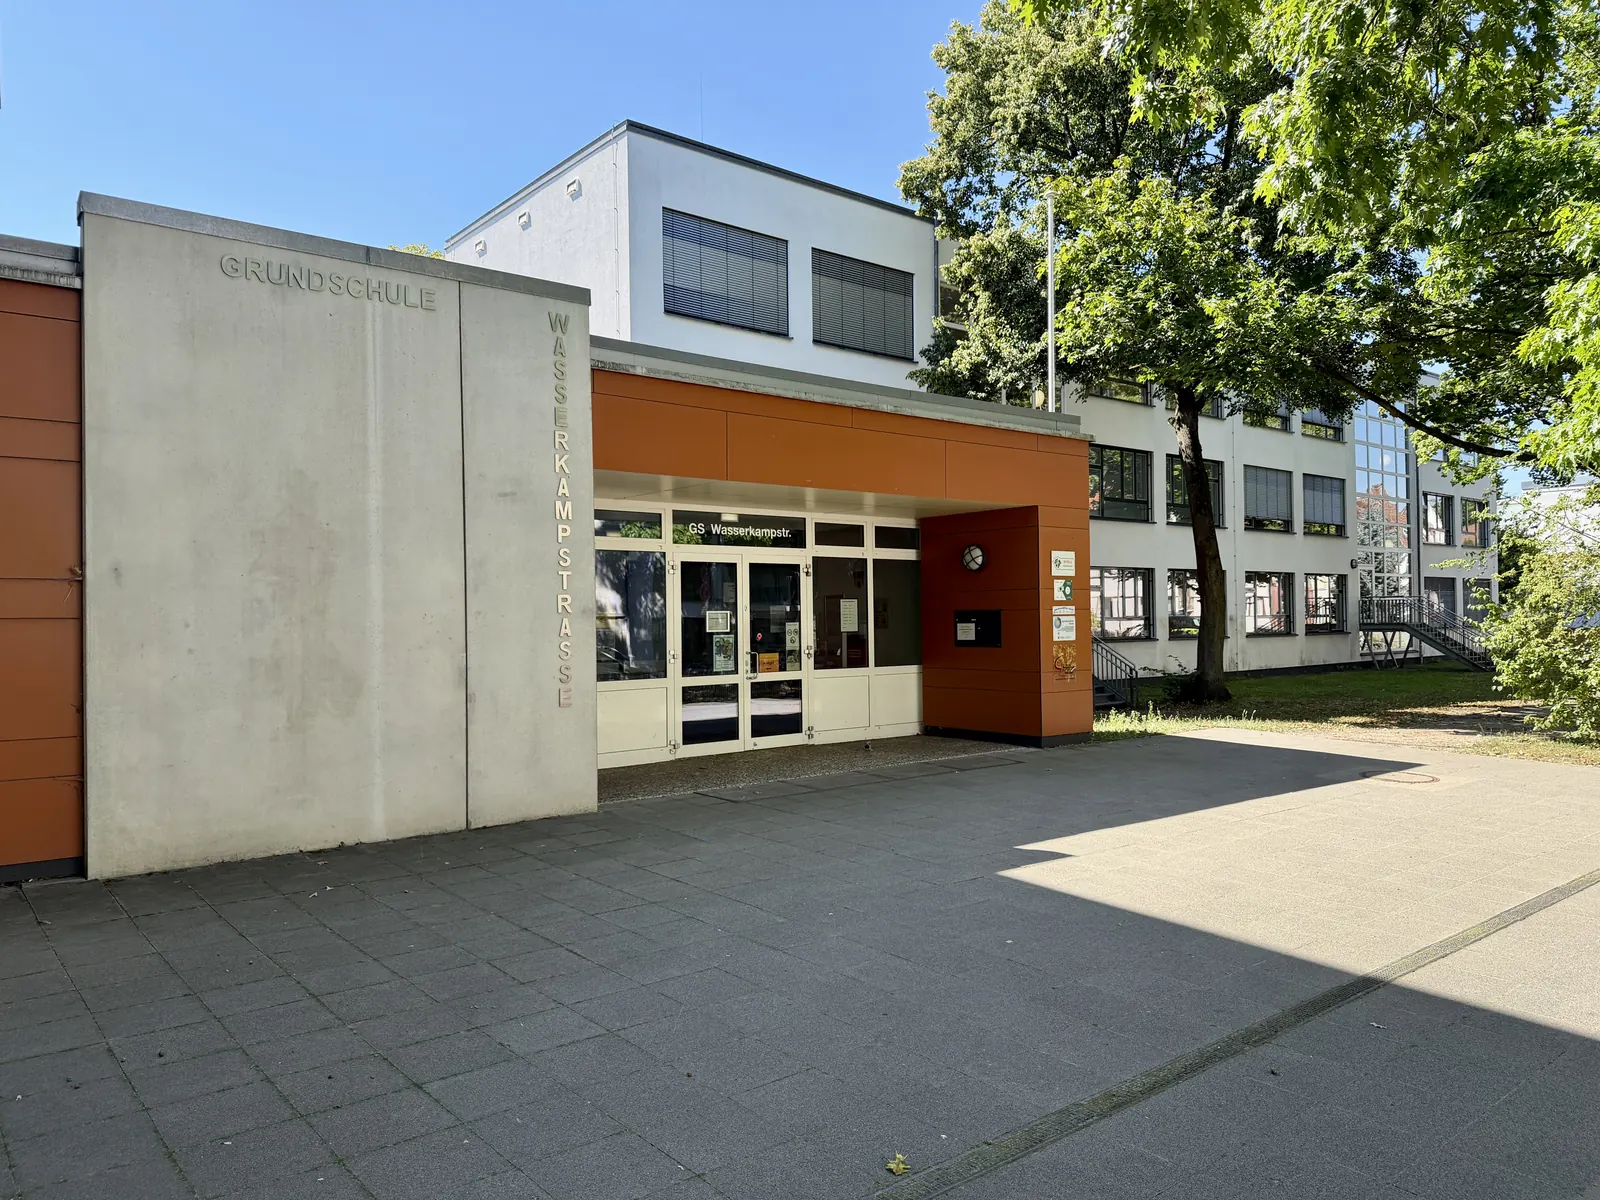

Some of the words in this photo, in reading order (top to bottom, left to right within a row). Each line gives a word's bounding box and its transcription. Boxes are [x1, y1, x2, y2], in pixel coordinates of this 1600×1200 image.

[220, 253, 436, 311] GRUNDSCHULE
[548, 311, 573, 708] WASSERKAMPSTRASSE
[689, 523, 705, 534] GS
[711, 523, 792, 539] Wasserkampstr.
